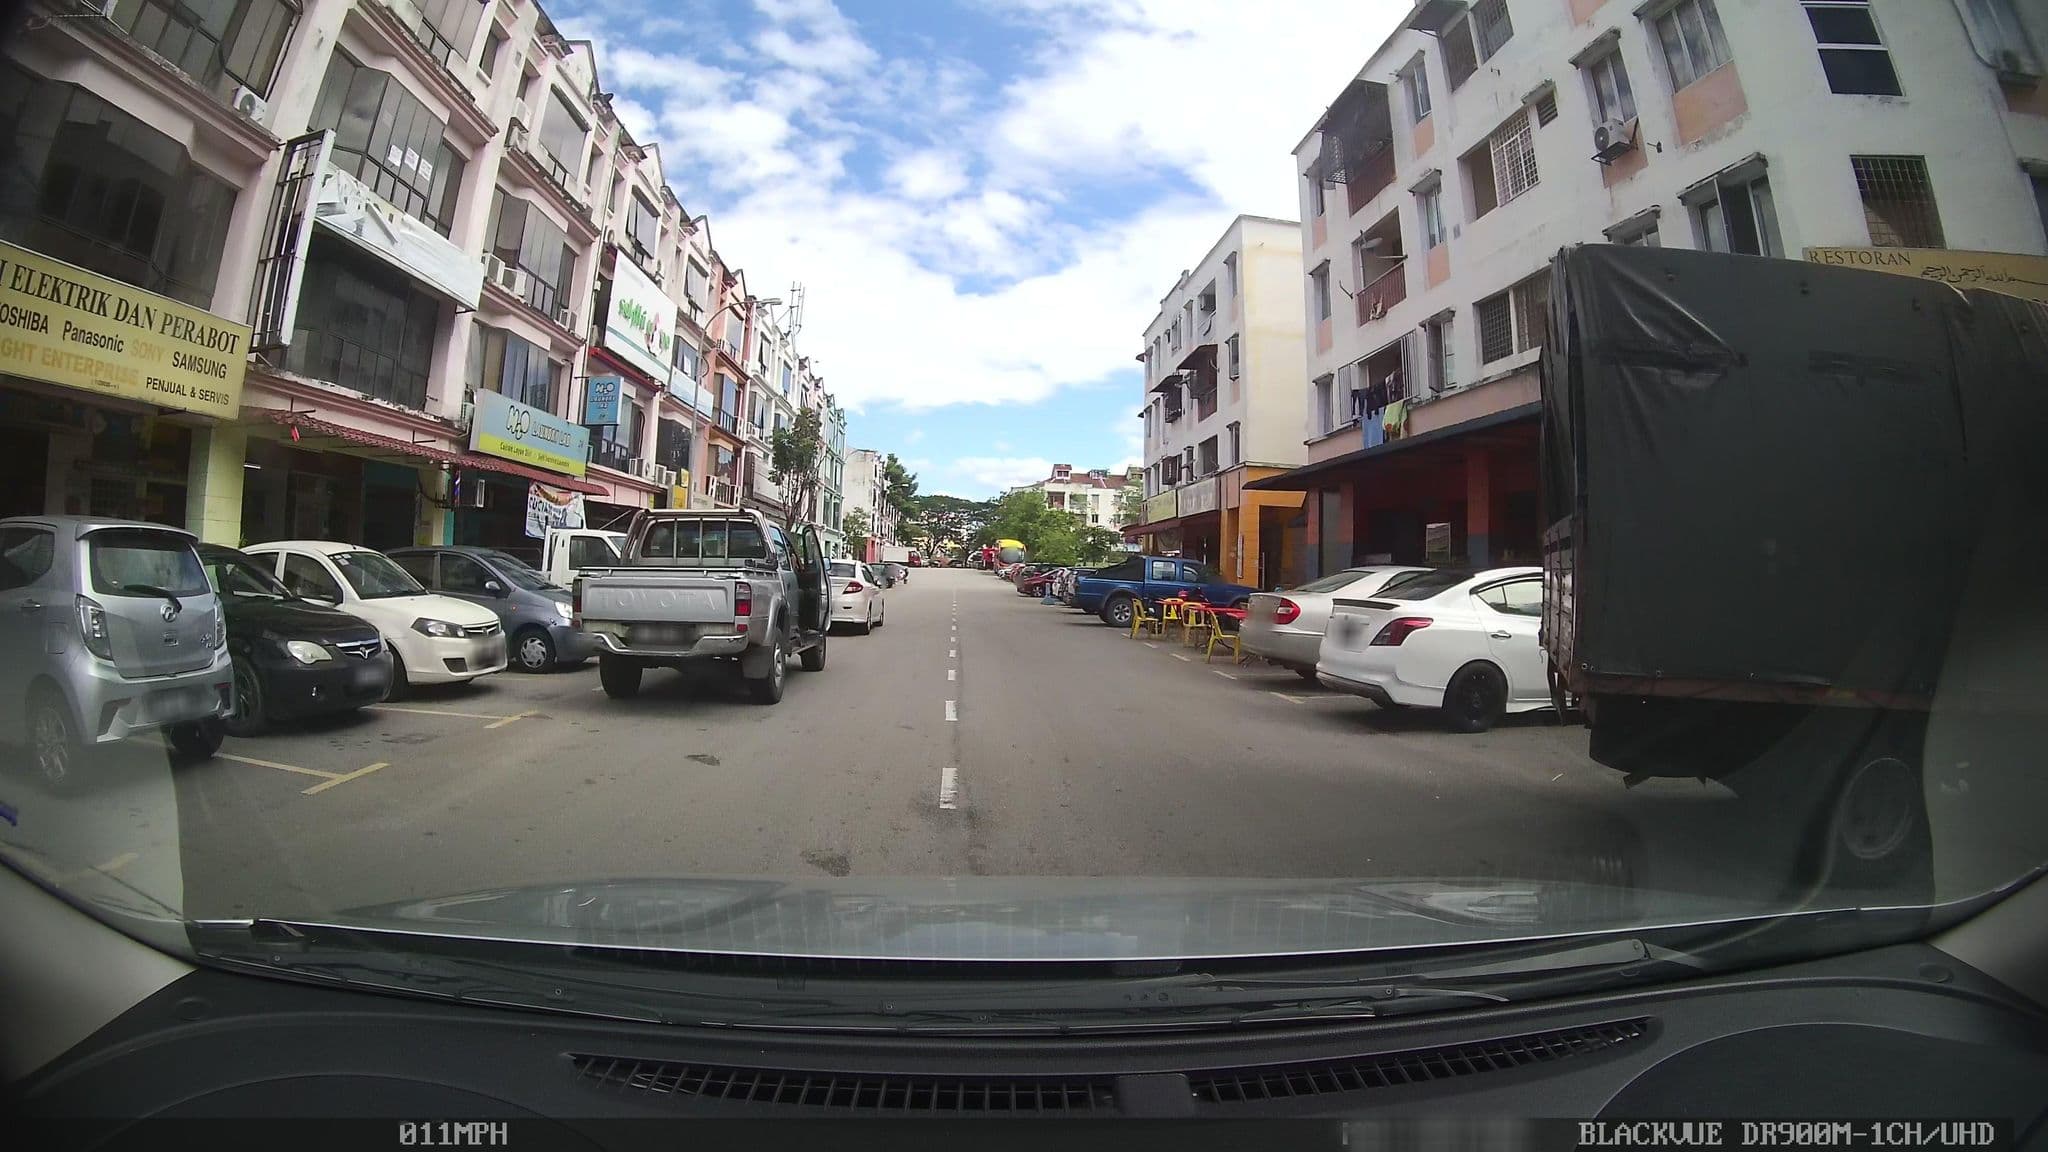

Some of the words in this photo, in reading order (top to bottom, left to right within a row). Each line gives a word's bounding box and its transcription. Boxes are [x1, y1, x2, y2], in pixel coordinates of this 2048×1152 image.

[1809, 250, 1912, 266] RESTORAN
[9, 263, 112, 317] ELEKTRIK
[113, 297, 158, 332] DAN
[159, 312, 240, 355] PERABOT
[0, 302, 49, 334] OSHIBA
[62, 320, 125, 353] Panasonic
[172, 351, 228, 379] SAMSUNG
[146, 376, 188, 397] PENJUAL
[190, 386, 196, 398] &
[198, 389, 230, 406] SERVIS
